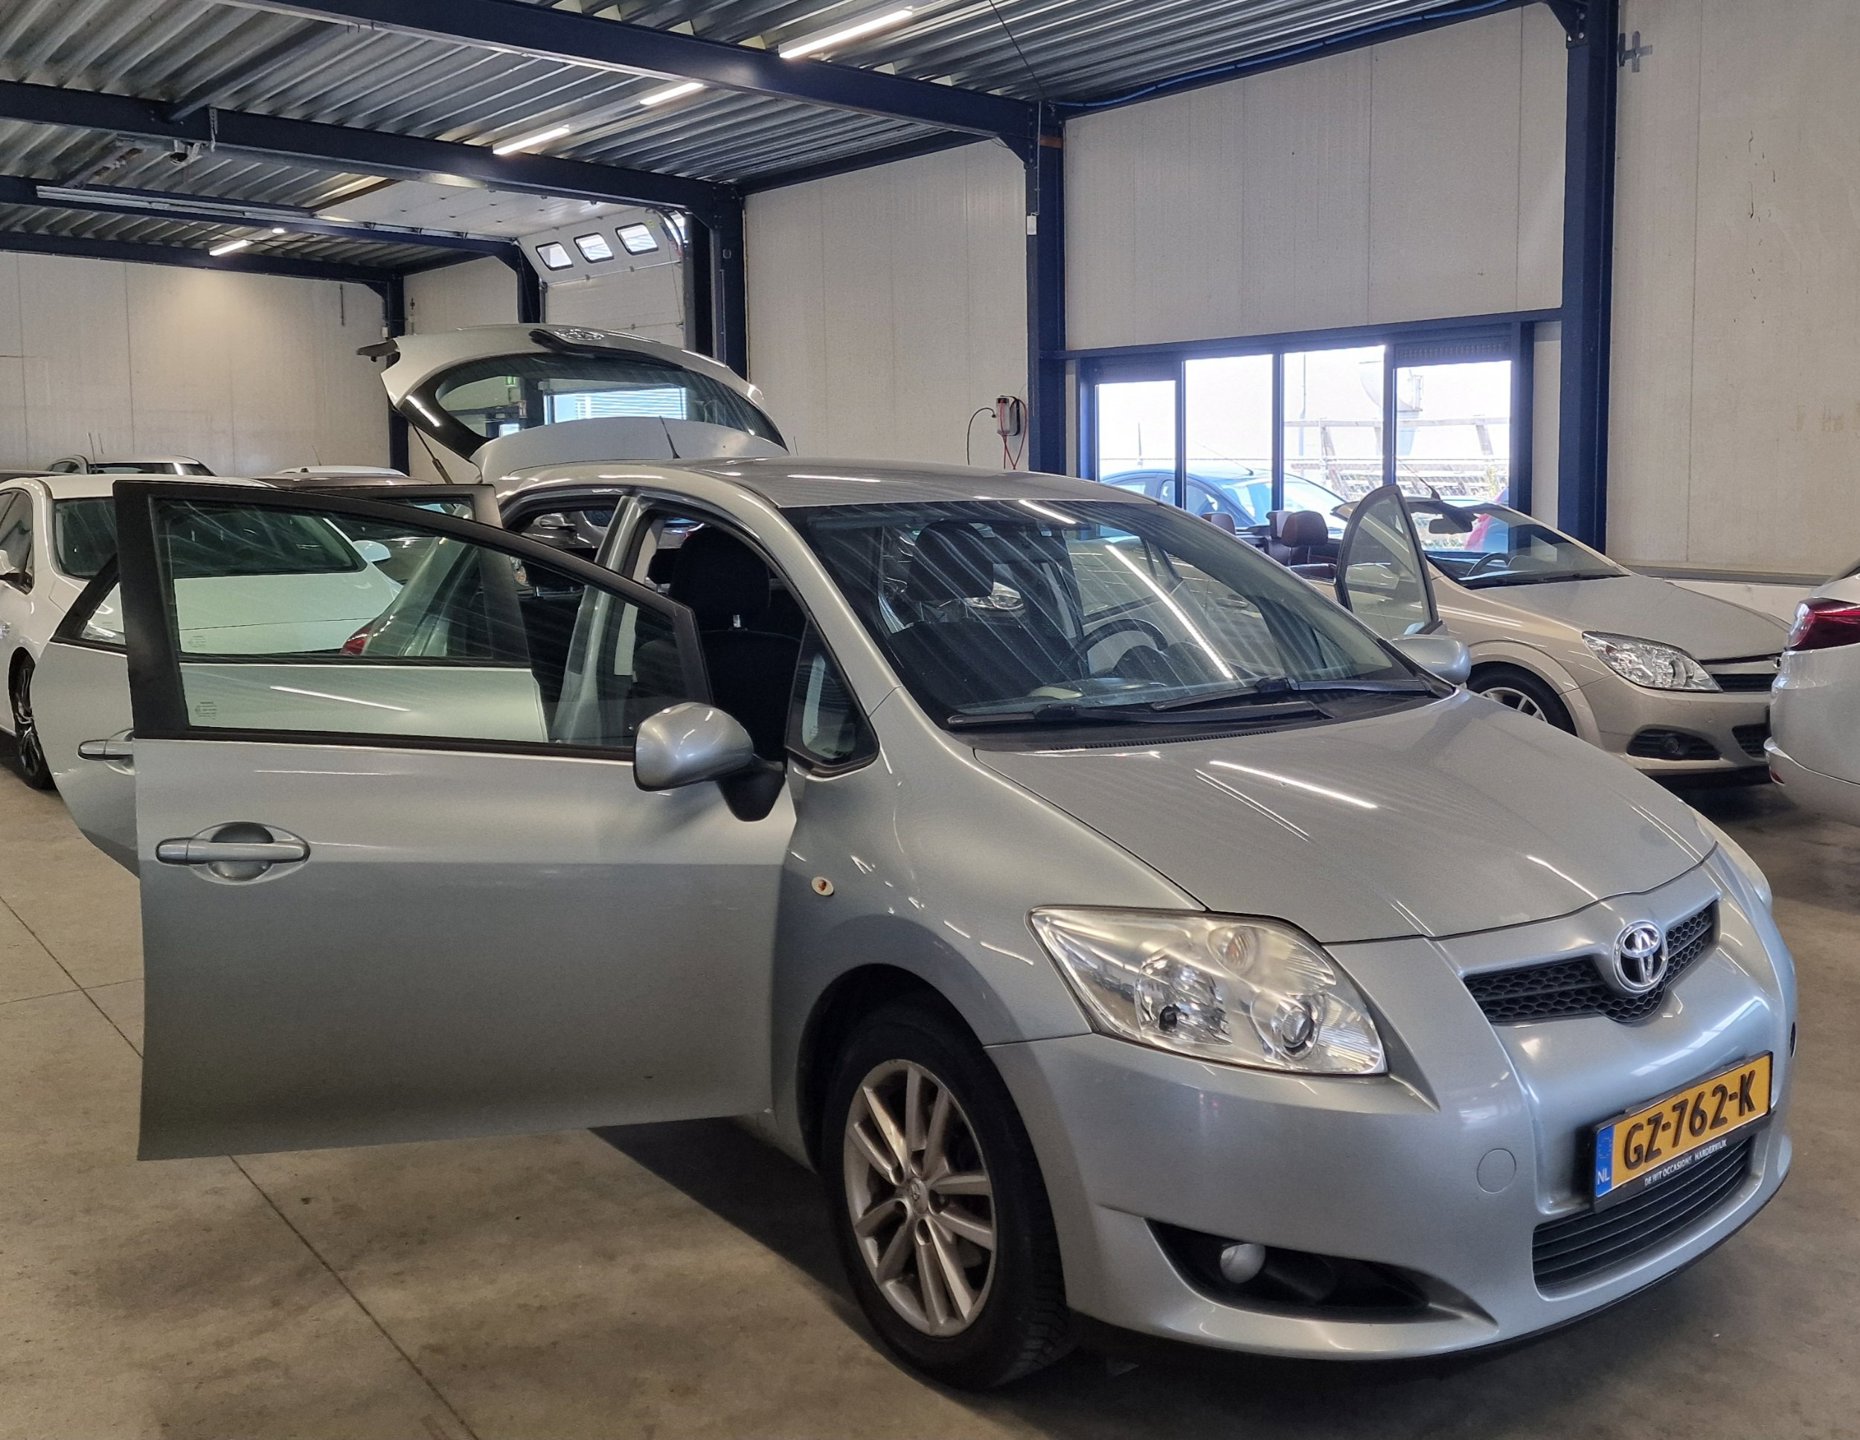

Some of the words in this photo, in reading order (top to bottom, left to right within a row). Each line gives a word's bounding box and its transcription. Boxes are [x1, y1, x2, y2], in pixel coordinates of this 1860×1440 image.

[1623, 1069, 1756, 1170] GZ-762-K
[1597, 1167, 1611, 1185] NL
[1662, 1155, 1694, 1177] OCCASIONS
